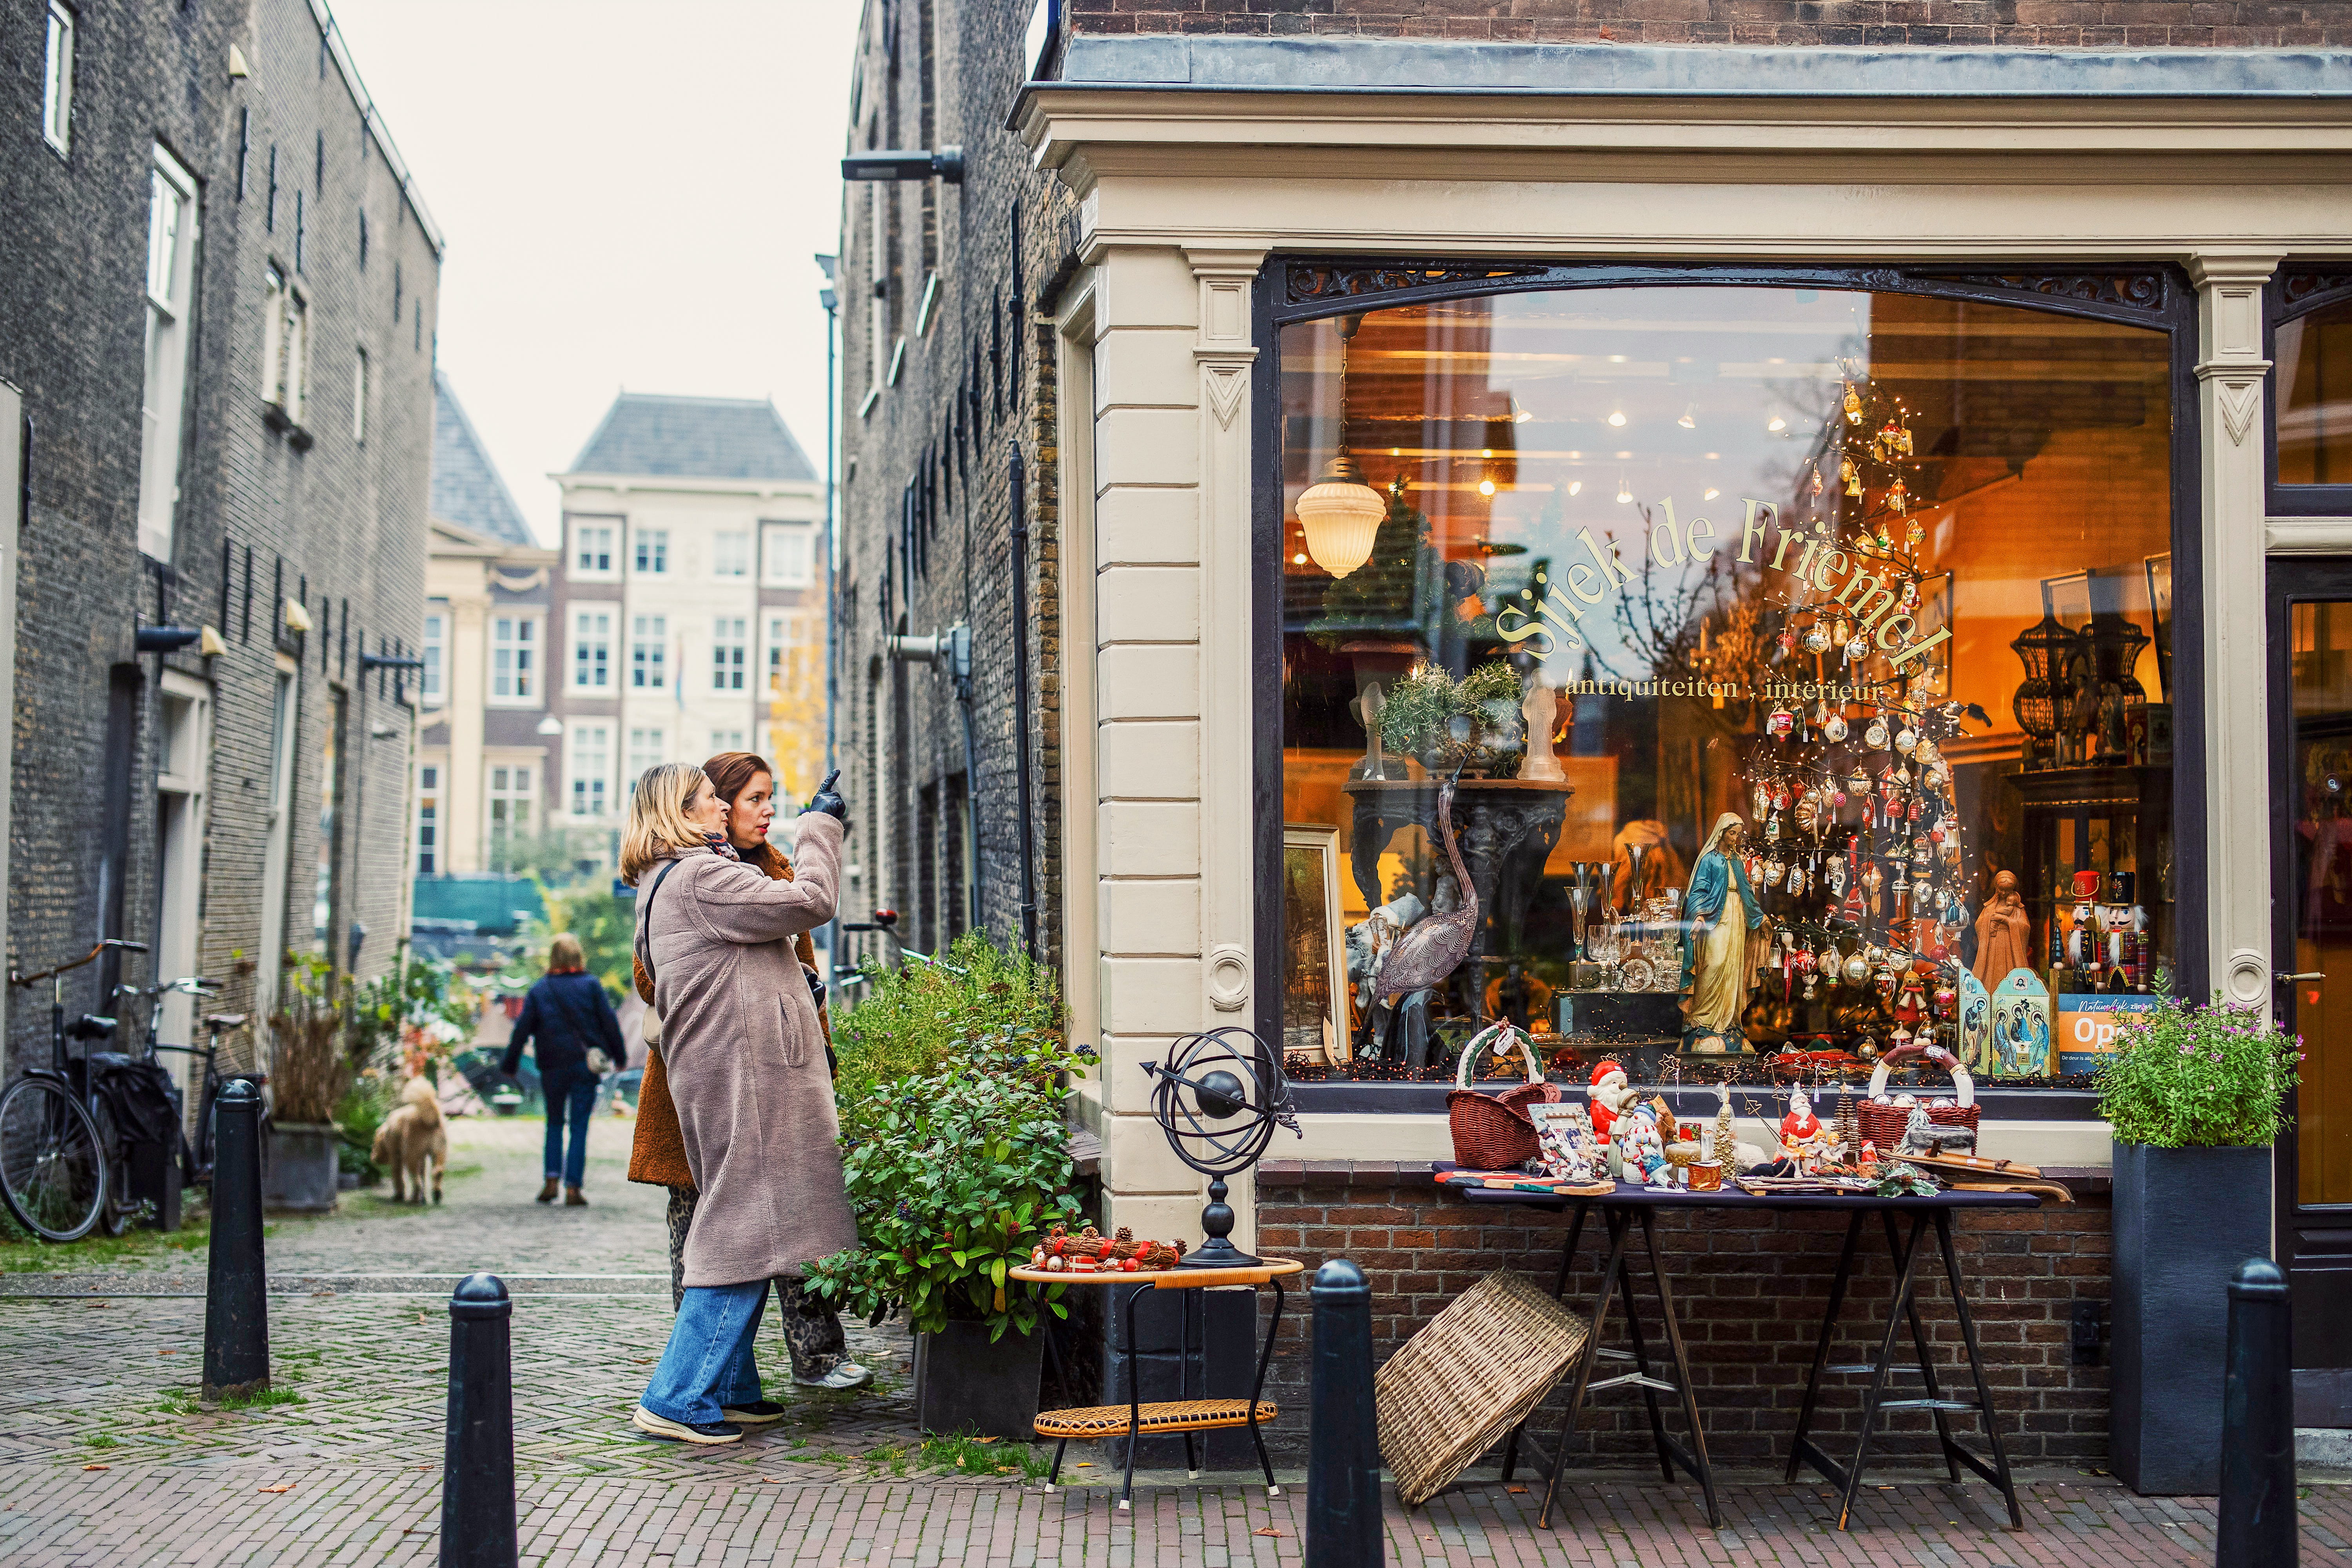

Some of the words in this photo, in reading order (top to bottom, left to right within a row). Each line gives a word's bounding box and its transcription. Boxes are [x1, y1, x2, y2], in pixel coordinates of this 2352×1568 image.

[1495, 526, 1639, 663] Sjiek
[1650, 496, 1715, 568] de
[1736, 497, 1953, 670] Friemel
[1565, 675, 1739, 702] antiquiteiten
[1765, 678, 1883, 701] interieur
